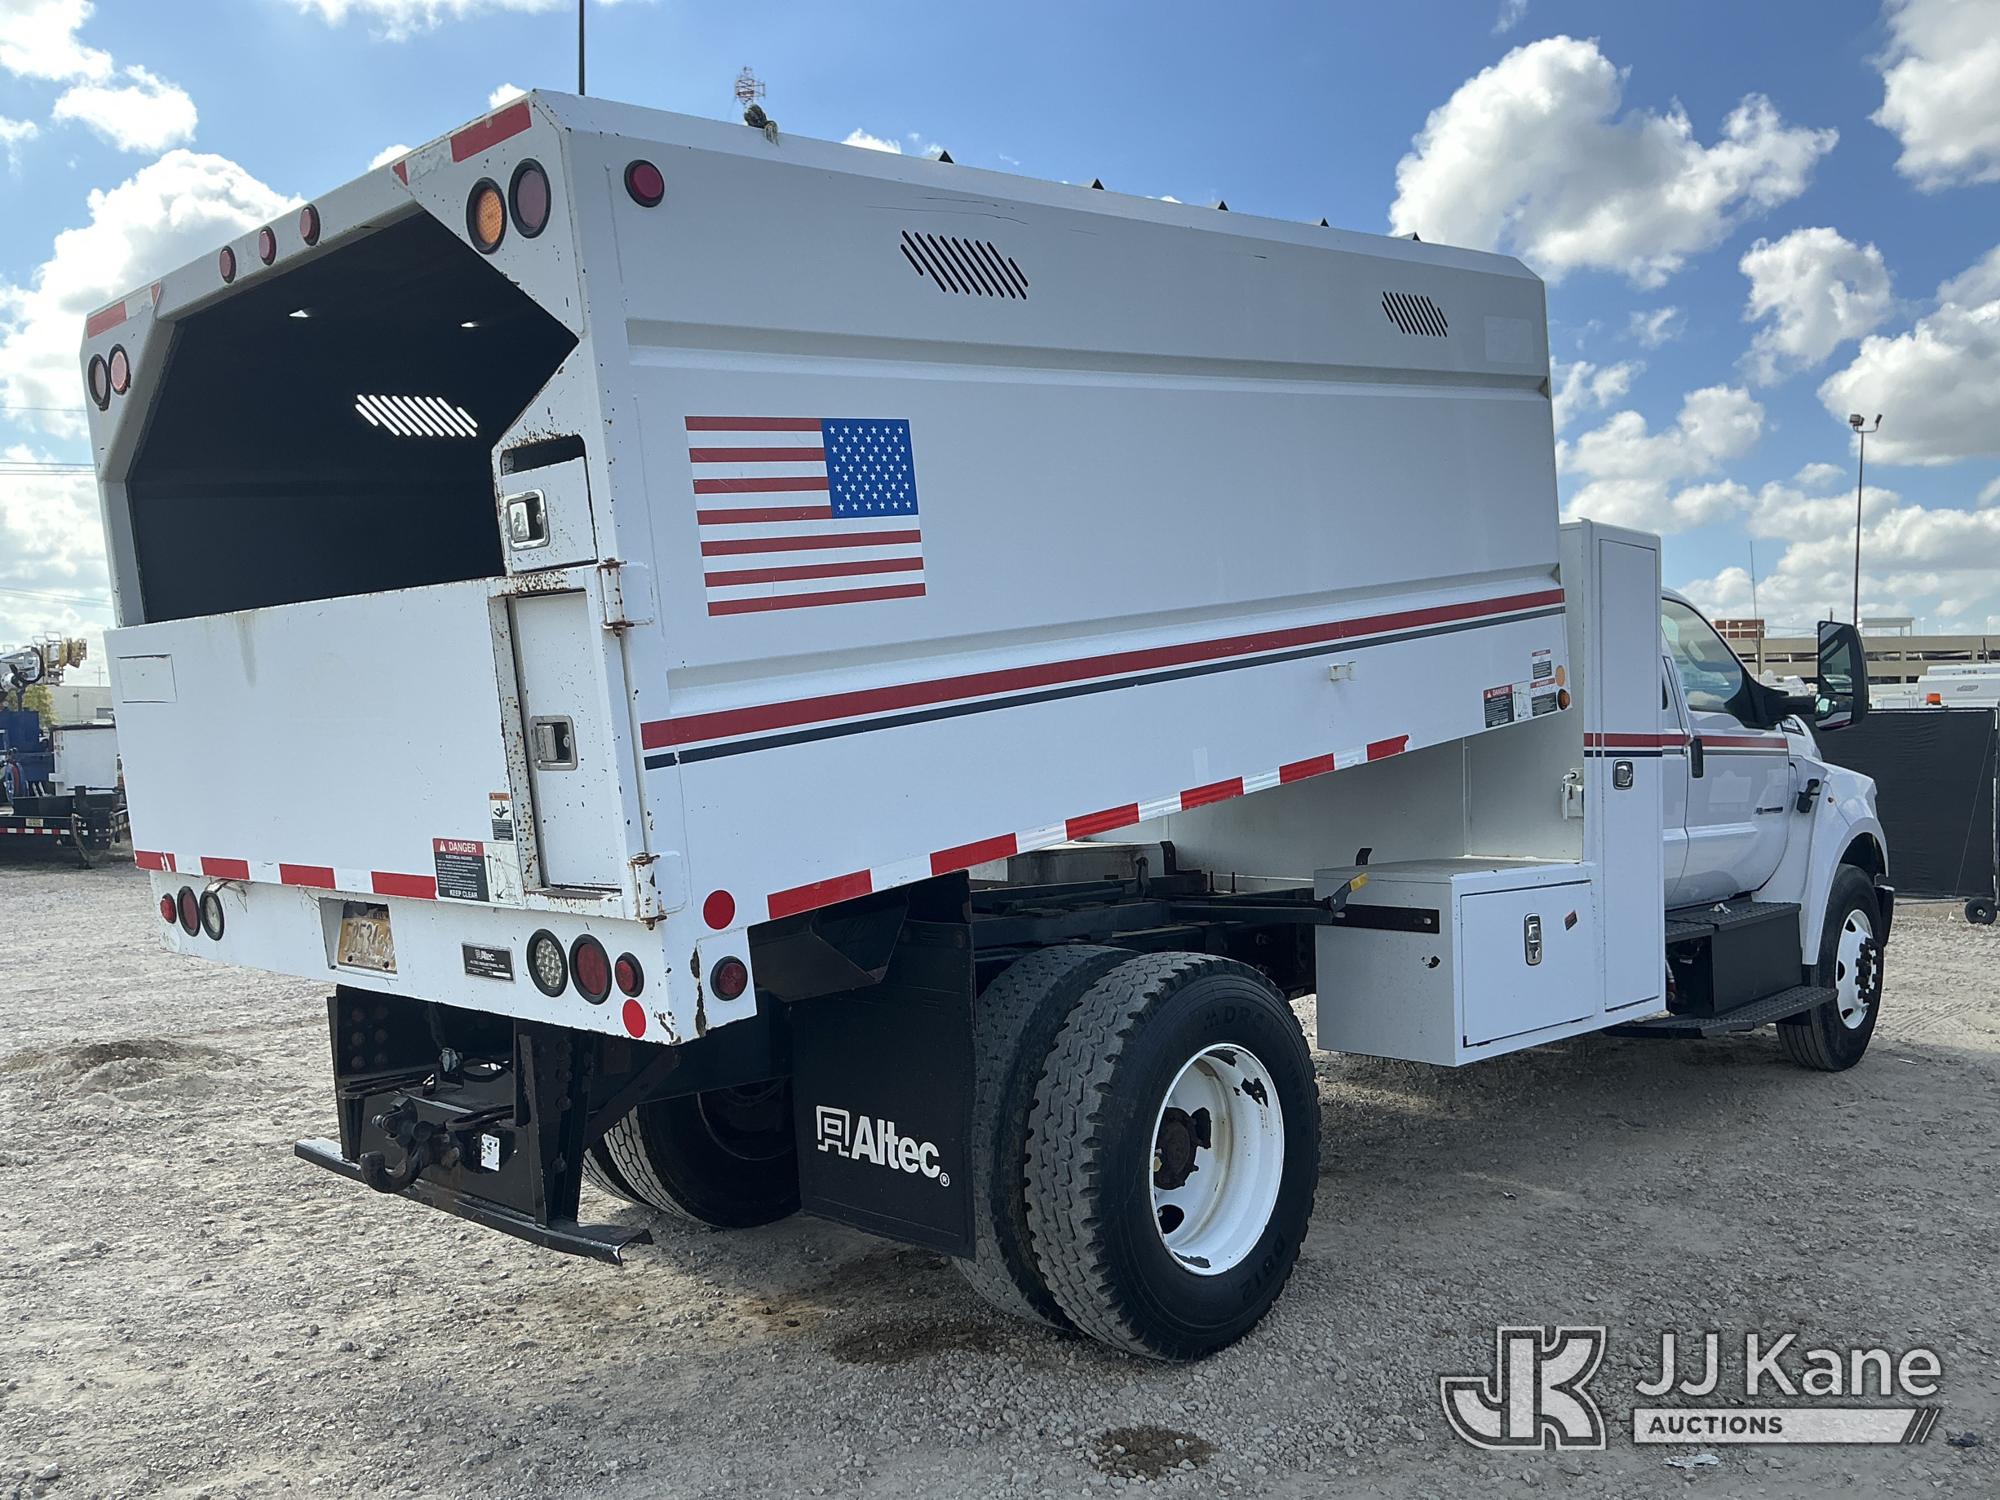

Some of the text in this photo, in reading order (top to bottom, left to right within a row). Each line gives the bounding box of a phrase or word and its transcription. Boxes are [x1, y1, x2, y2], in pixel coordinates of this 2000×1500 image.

[448, 841, 477, 853] DANGER
[449, 889, 478, 899] KEEP CLEAR
[851, 1115, 941, 1179] Altec
